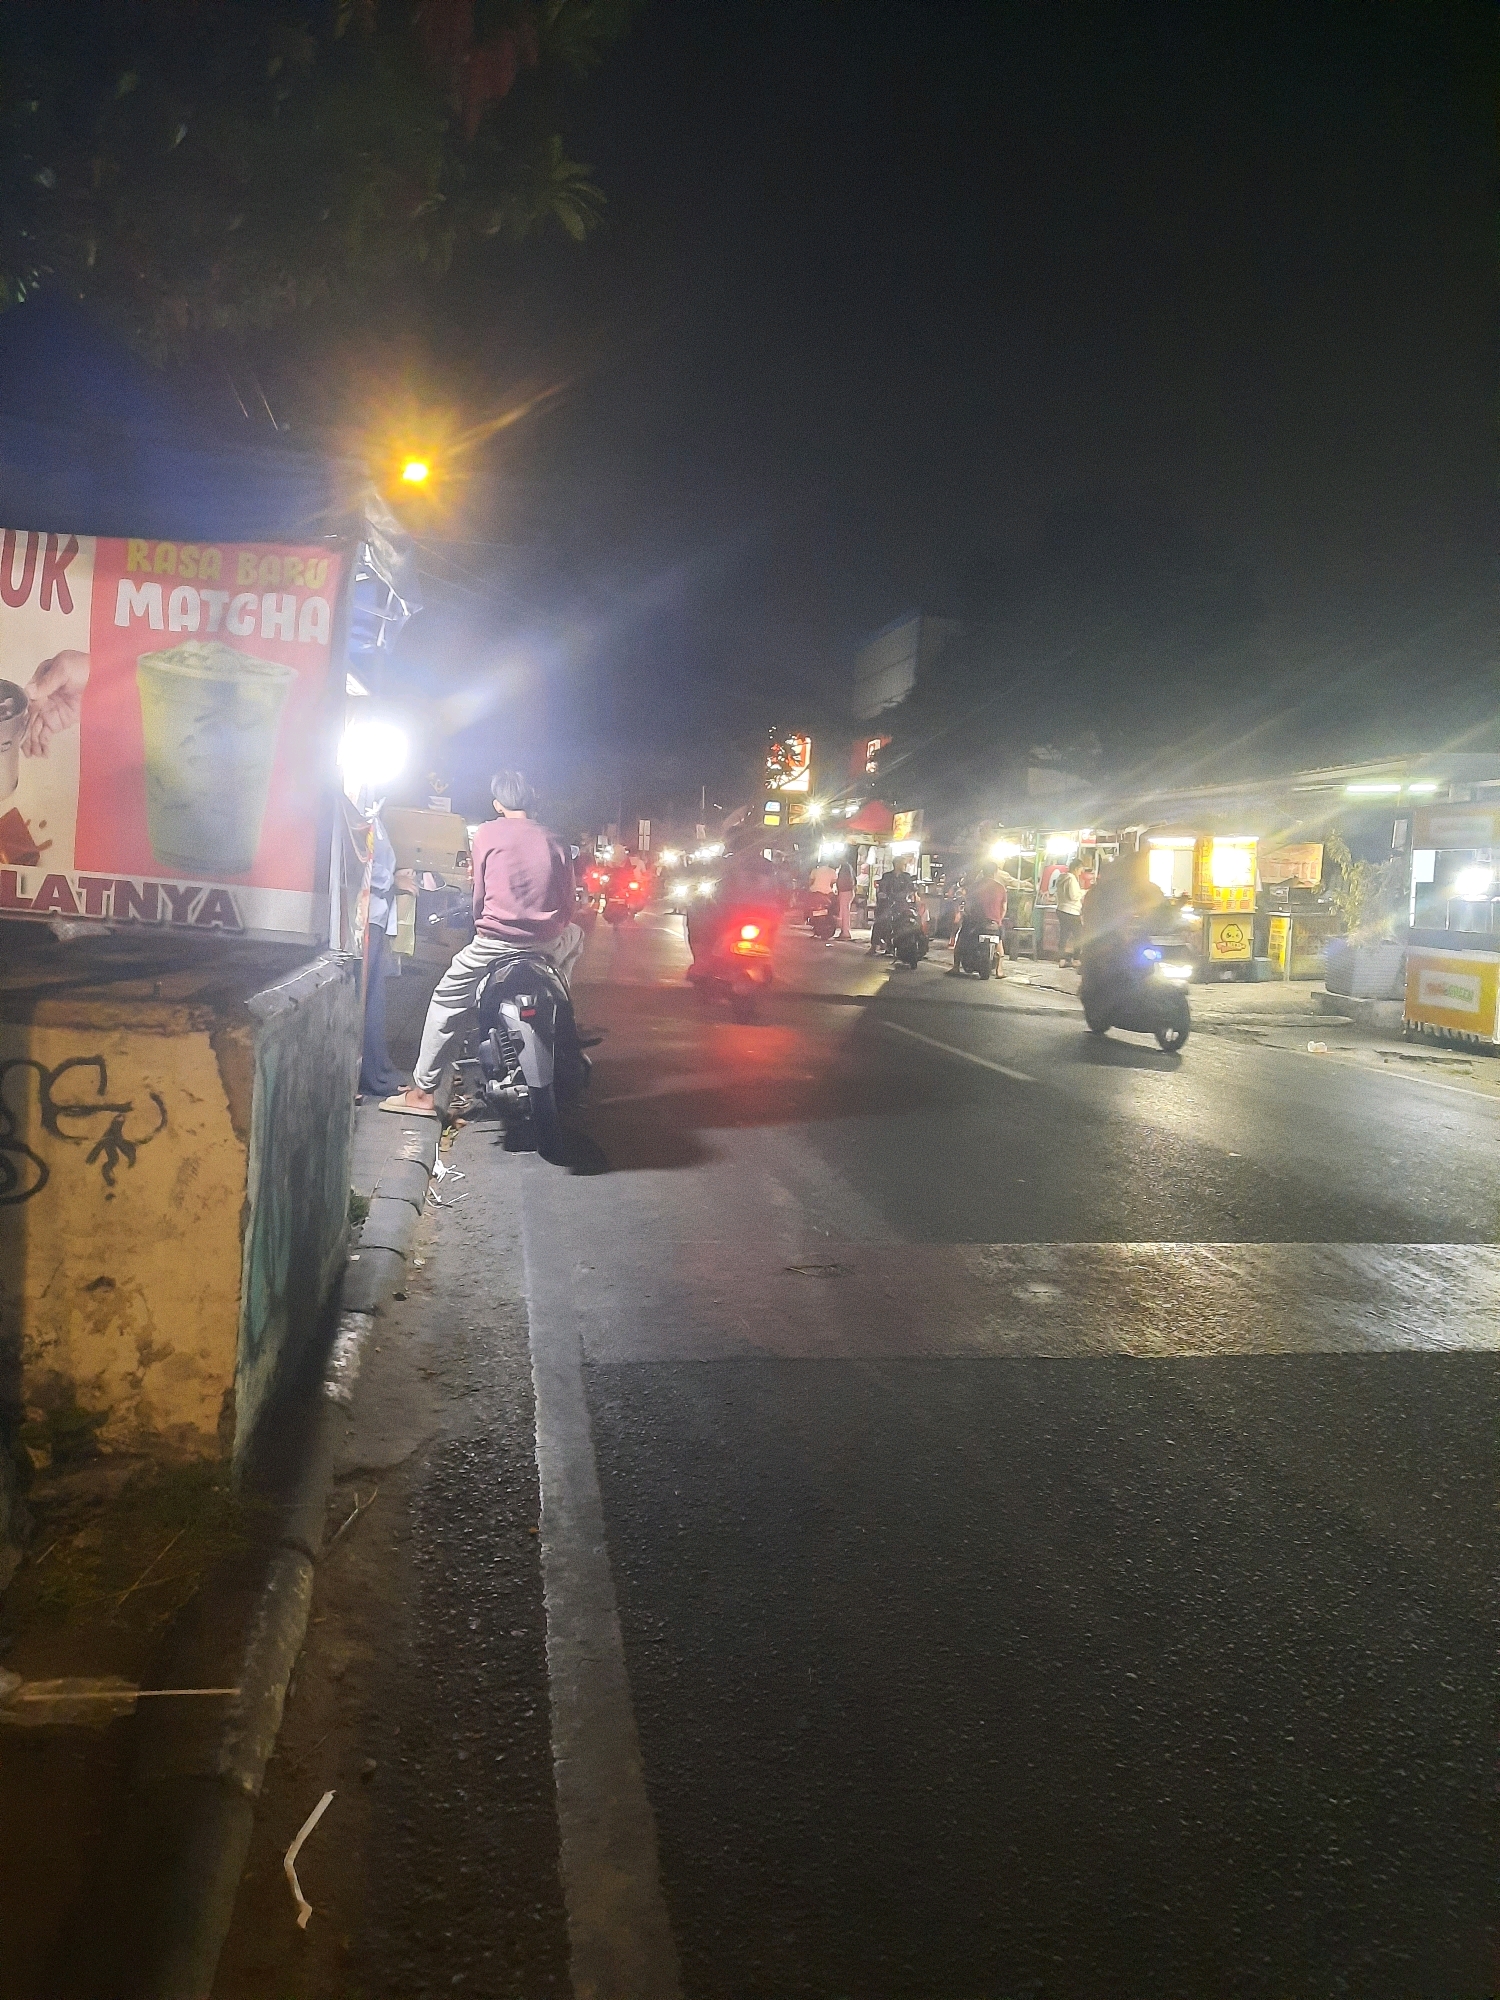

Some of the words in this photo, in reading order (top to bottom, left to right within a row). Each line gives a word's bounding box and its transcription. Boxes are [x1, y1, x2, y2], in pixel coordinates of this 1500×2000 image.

[126, 538, 222, 581] RASA
[236, 551, 329, 590] BARU
[114, 578, 331, 645] MATCHA
[0, 868, 243, 930] LATNYA
